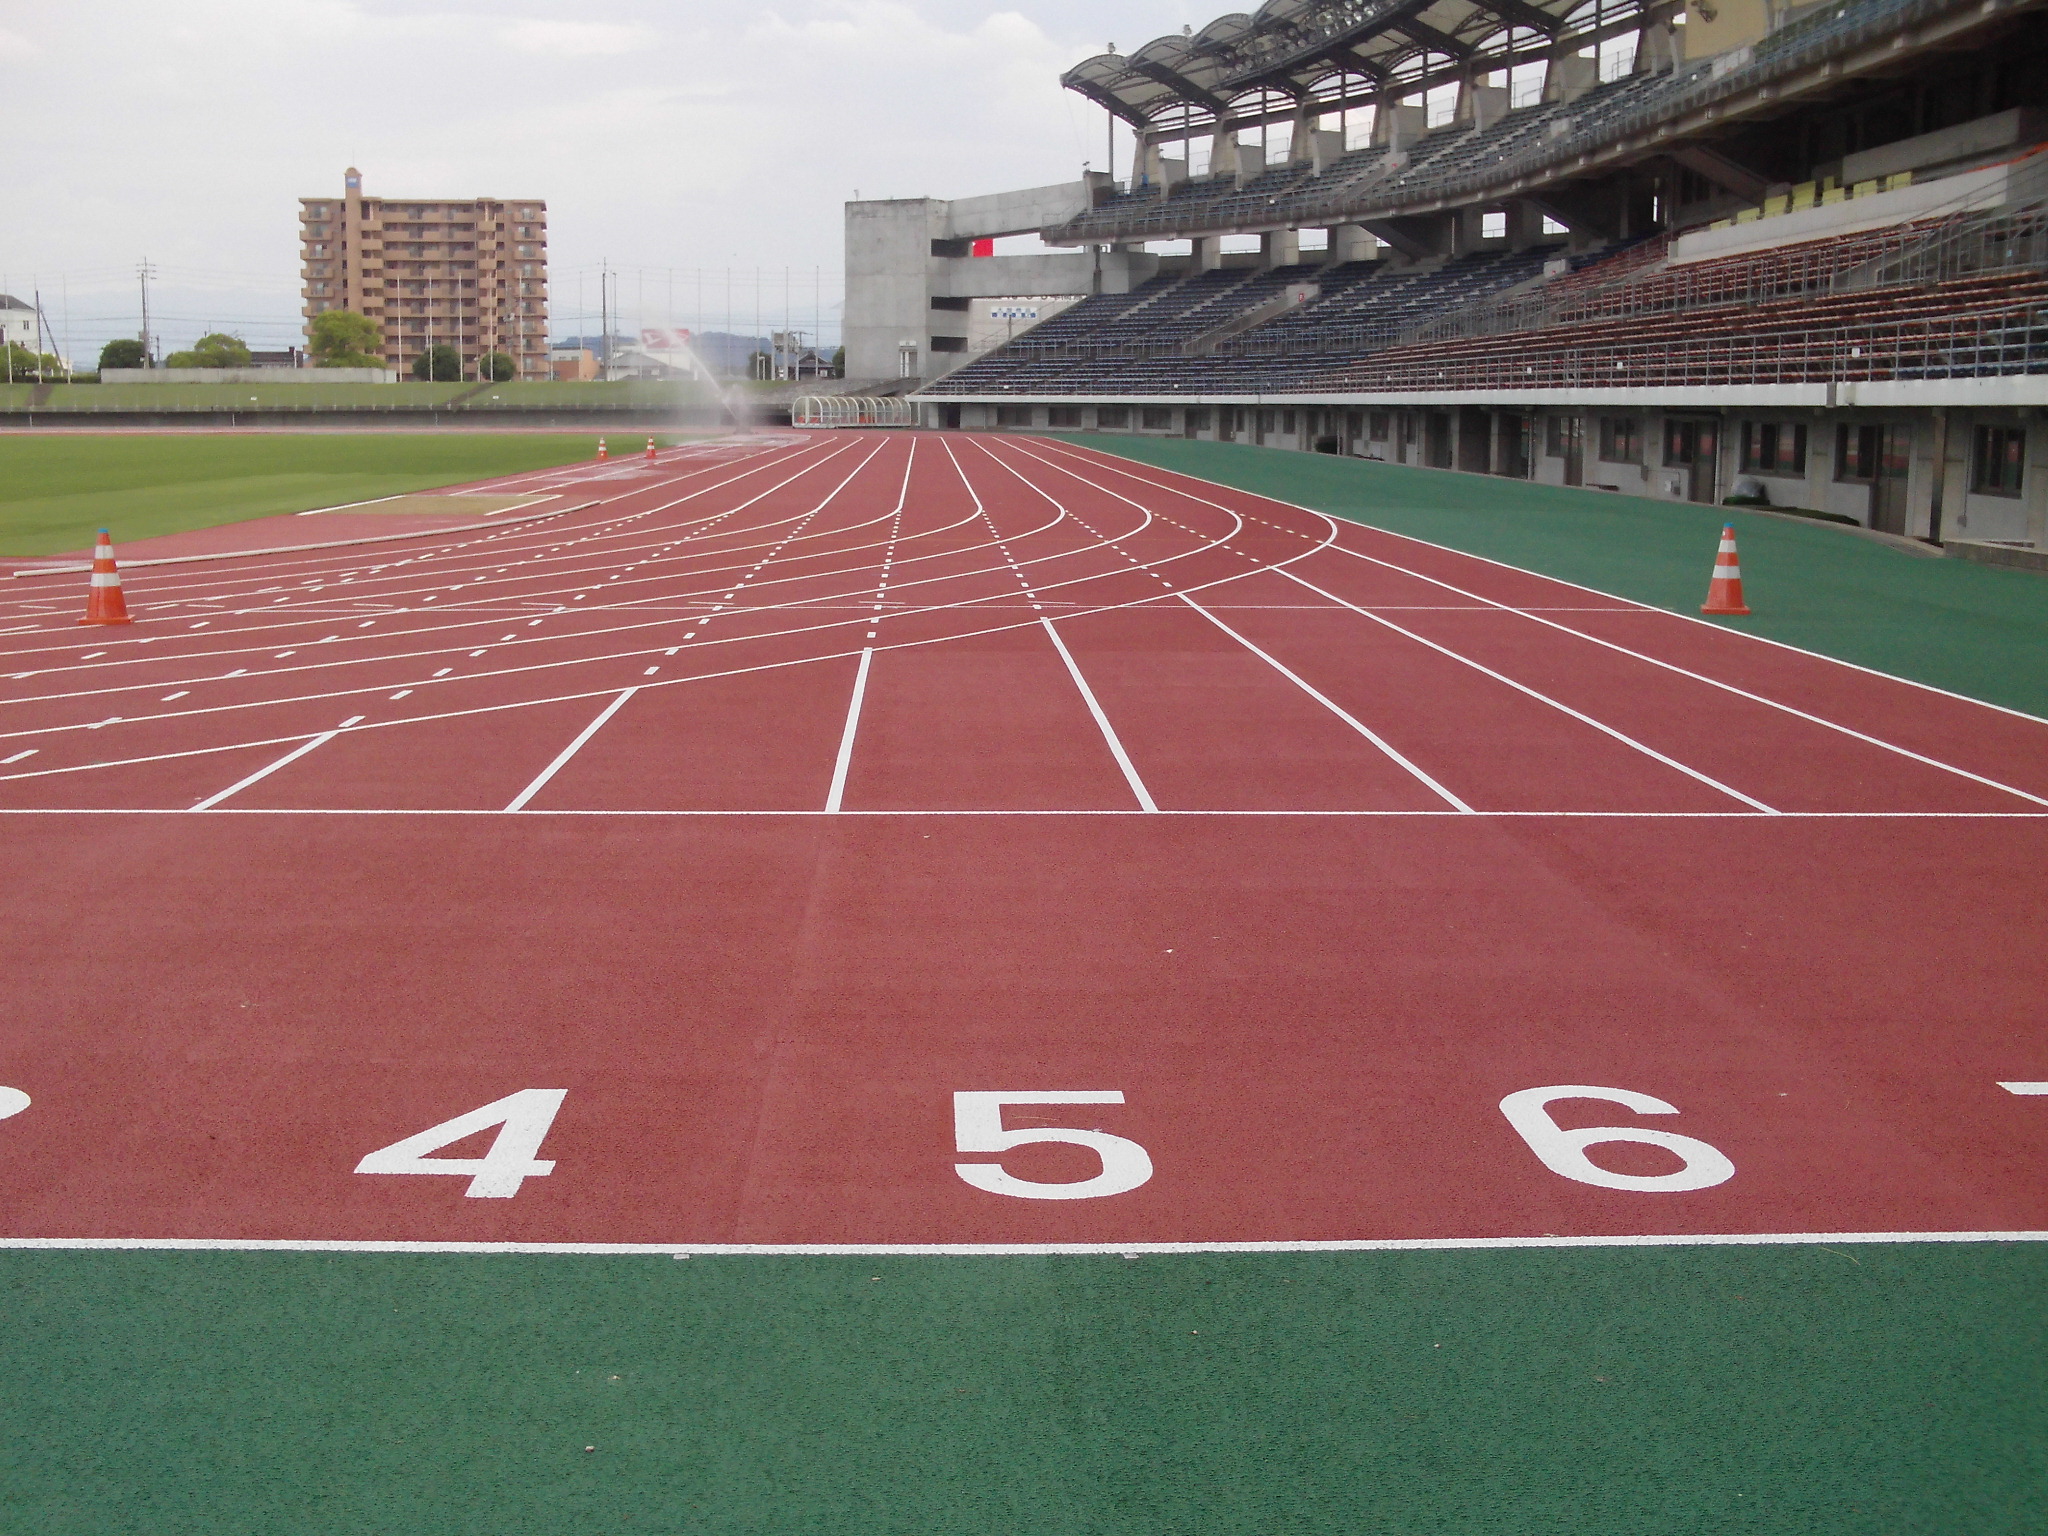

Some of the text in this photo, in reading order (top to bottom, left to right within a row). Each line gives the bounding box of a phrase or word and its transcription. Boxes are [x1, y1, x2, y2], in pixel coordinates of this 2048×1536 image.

[354, 1088, 569, 1199] 4
[953, 1090, 1154, 1201] 5
[1499, 1085, 1735, 1193] 6
